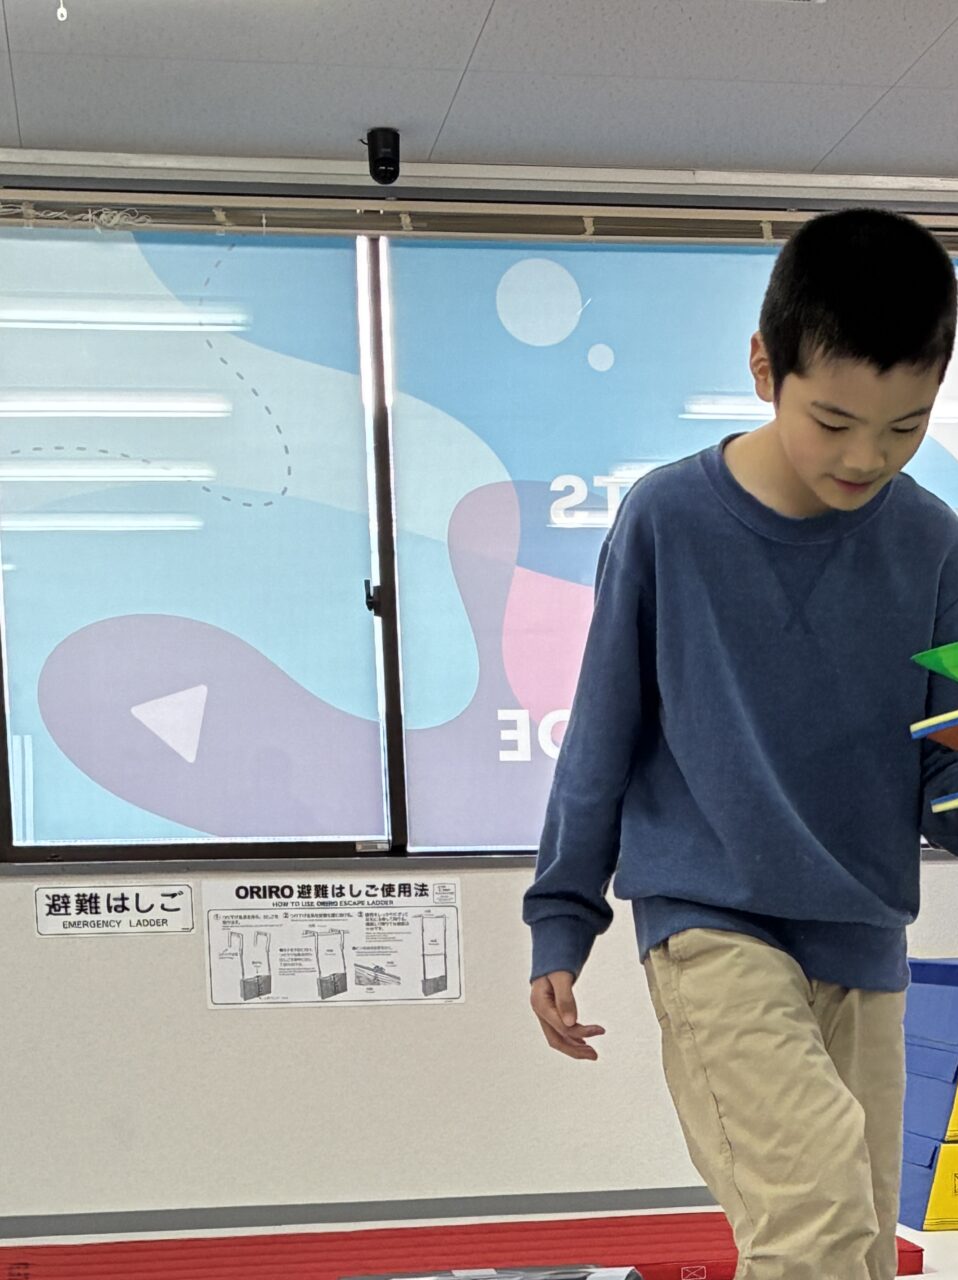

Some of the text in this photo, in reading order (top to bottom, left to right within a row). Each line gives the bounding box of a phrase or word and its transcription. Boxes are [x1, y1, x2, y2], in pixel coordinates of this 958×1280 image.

[45, 890, 184, 916] 避難はしご
[62, 918, 169, 929] EMERGENCY LADDER
